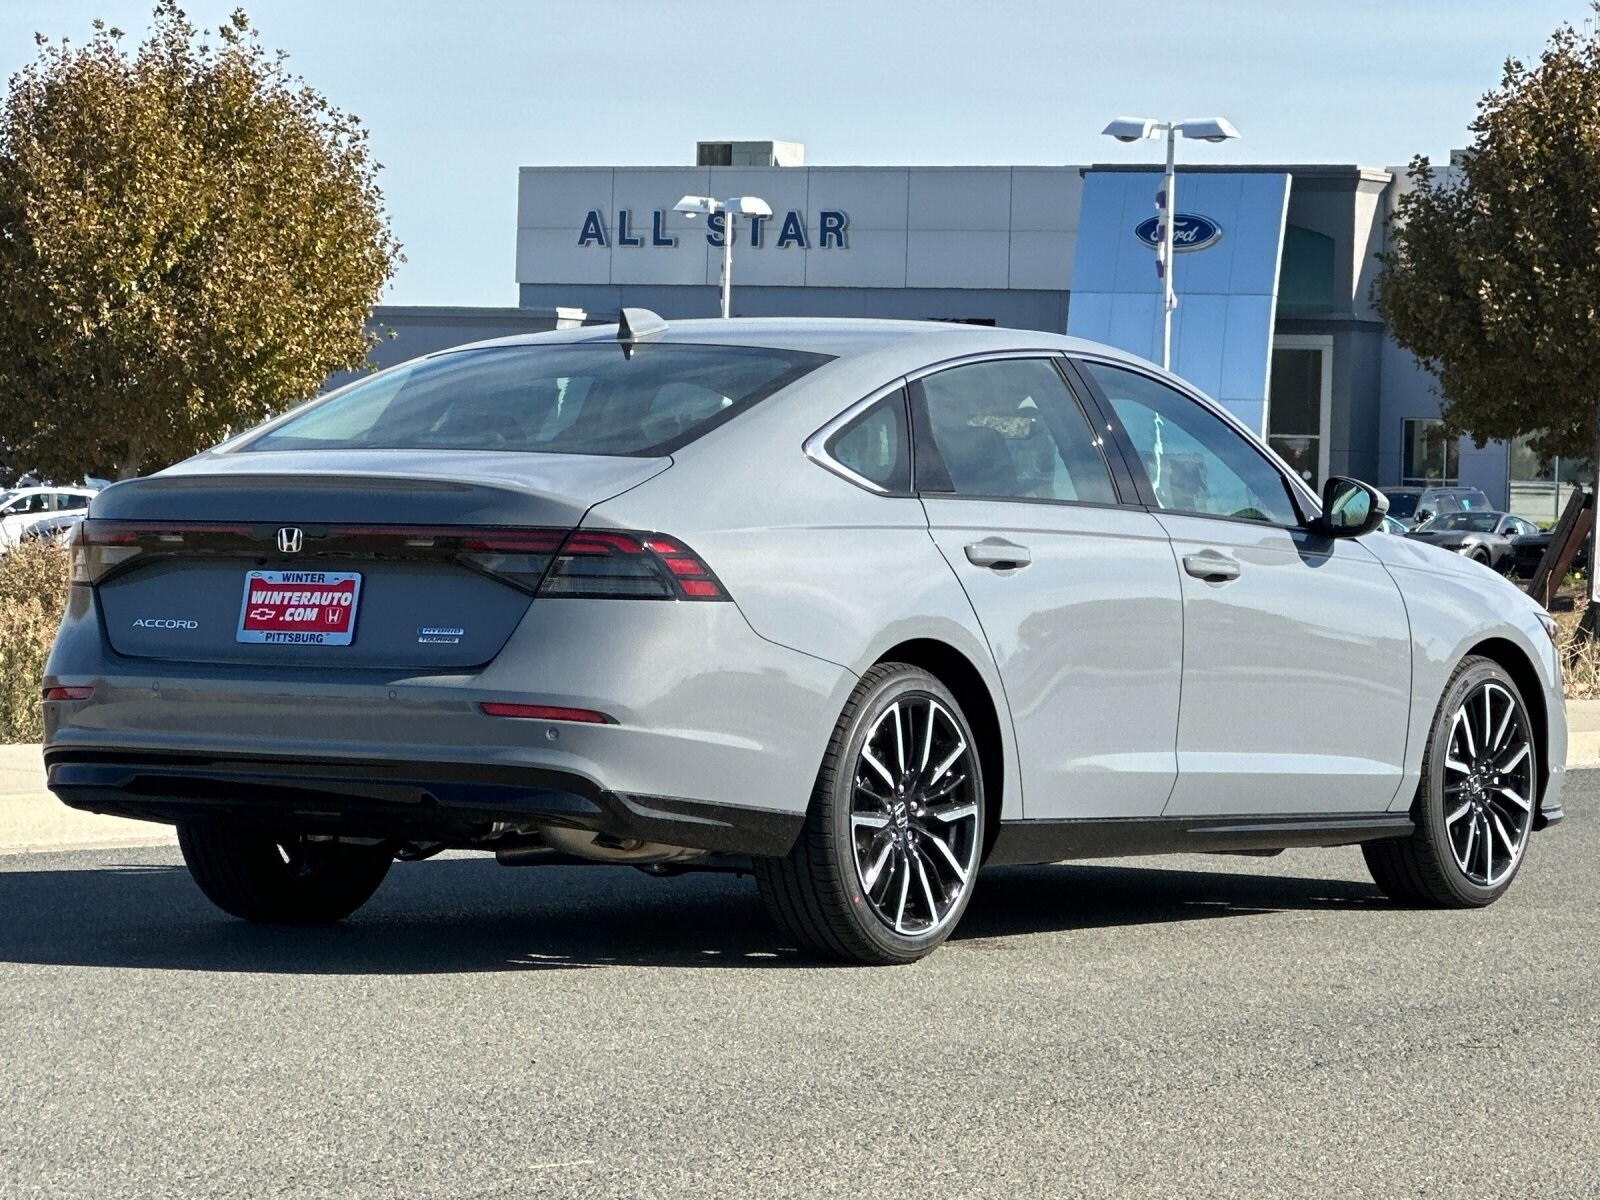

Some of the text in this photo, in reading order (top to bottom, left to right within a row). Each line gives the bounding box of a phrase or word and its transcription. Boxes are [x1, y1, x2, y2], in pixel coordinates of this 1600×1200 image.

[578, 209, 850, 249] ALL STAR
[1150, 221, 1199, 242] Frd
[282, 573, 325, 583] WINTER
[251, 591, 353, 606] WINTERAUTO
[279, 608, 318, 621] .COM
[132, 618, 199, 629] ACCORD
[265, 632, 324, 643] PITTSBURG
